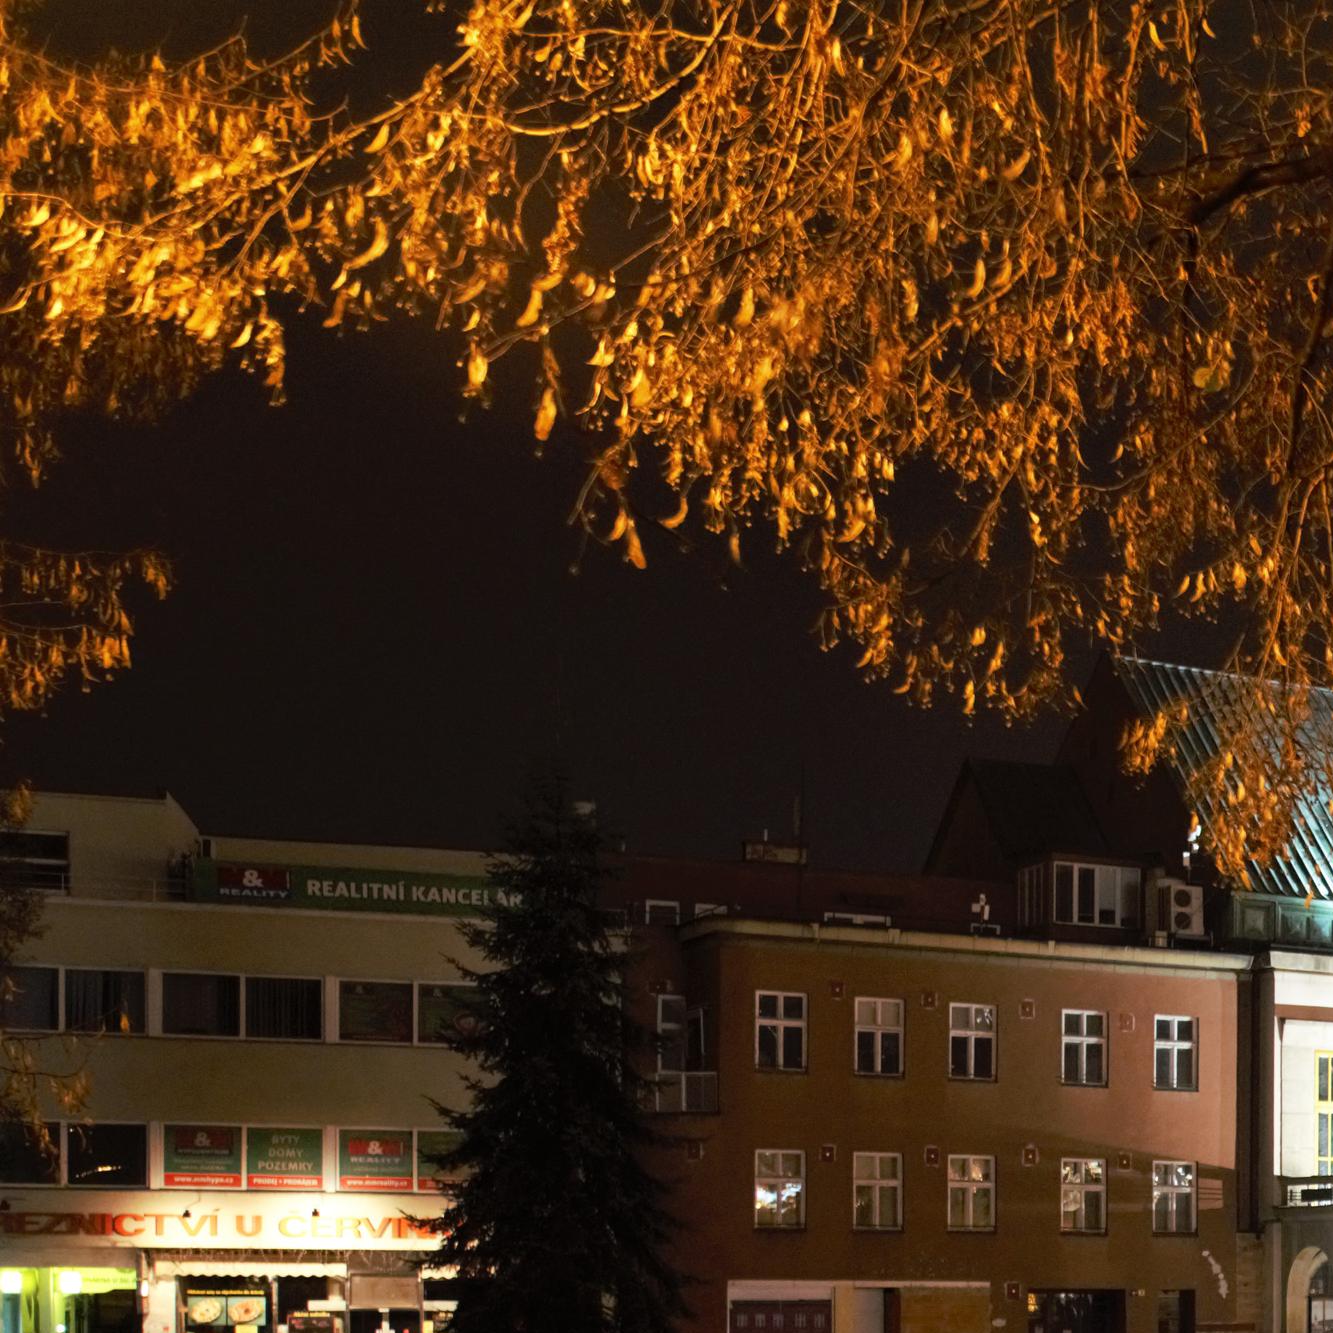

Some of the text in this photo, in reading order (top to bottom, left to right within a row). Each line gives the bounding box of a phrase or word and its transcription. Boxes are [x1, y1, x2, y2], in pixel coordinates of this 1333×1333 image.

[219, 887, 288, 899] REALITY
[307, 878, 404, 901] REALITNÍ
[272, 1135, 300, 1145] BYTY
[268, 1147, 303, 1158] DOMY
[257, 1160, 314, 1171] POZEMKY
[235, 1214, 263, 1237] U
